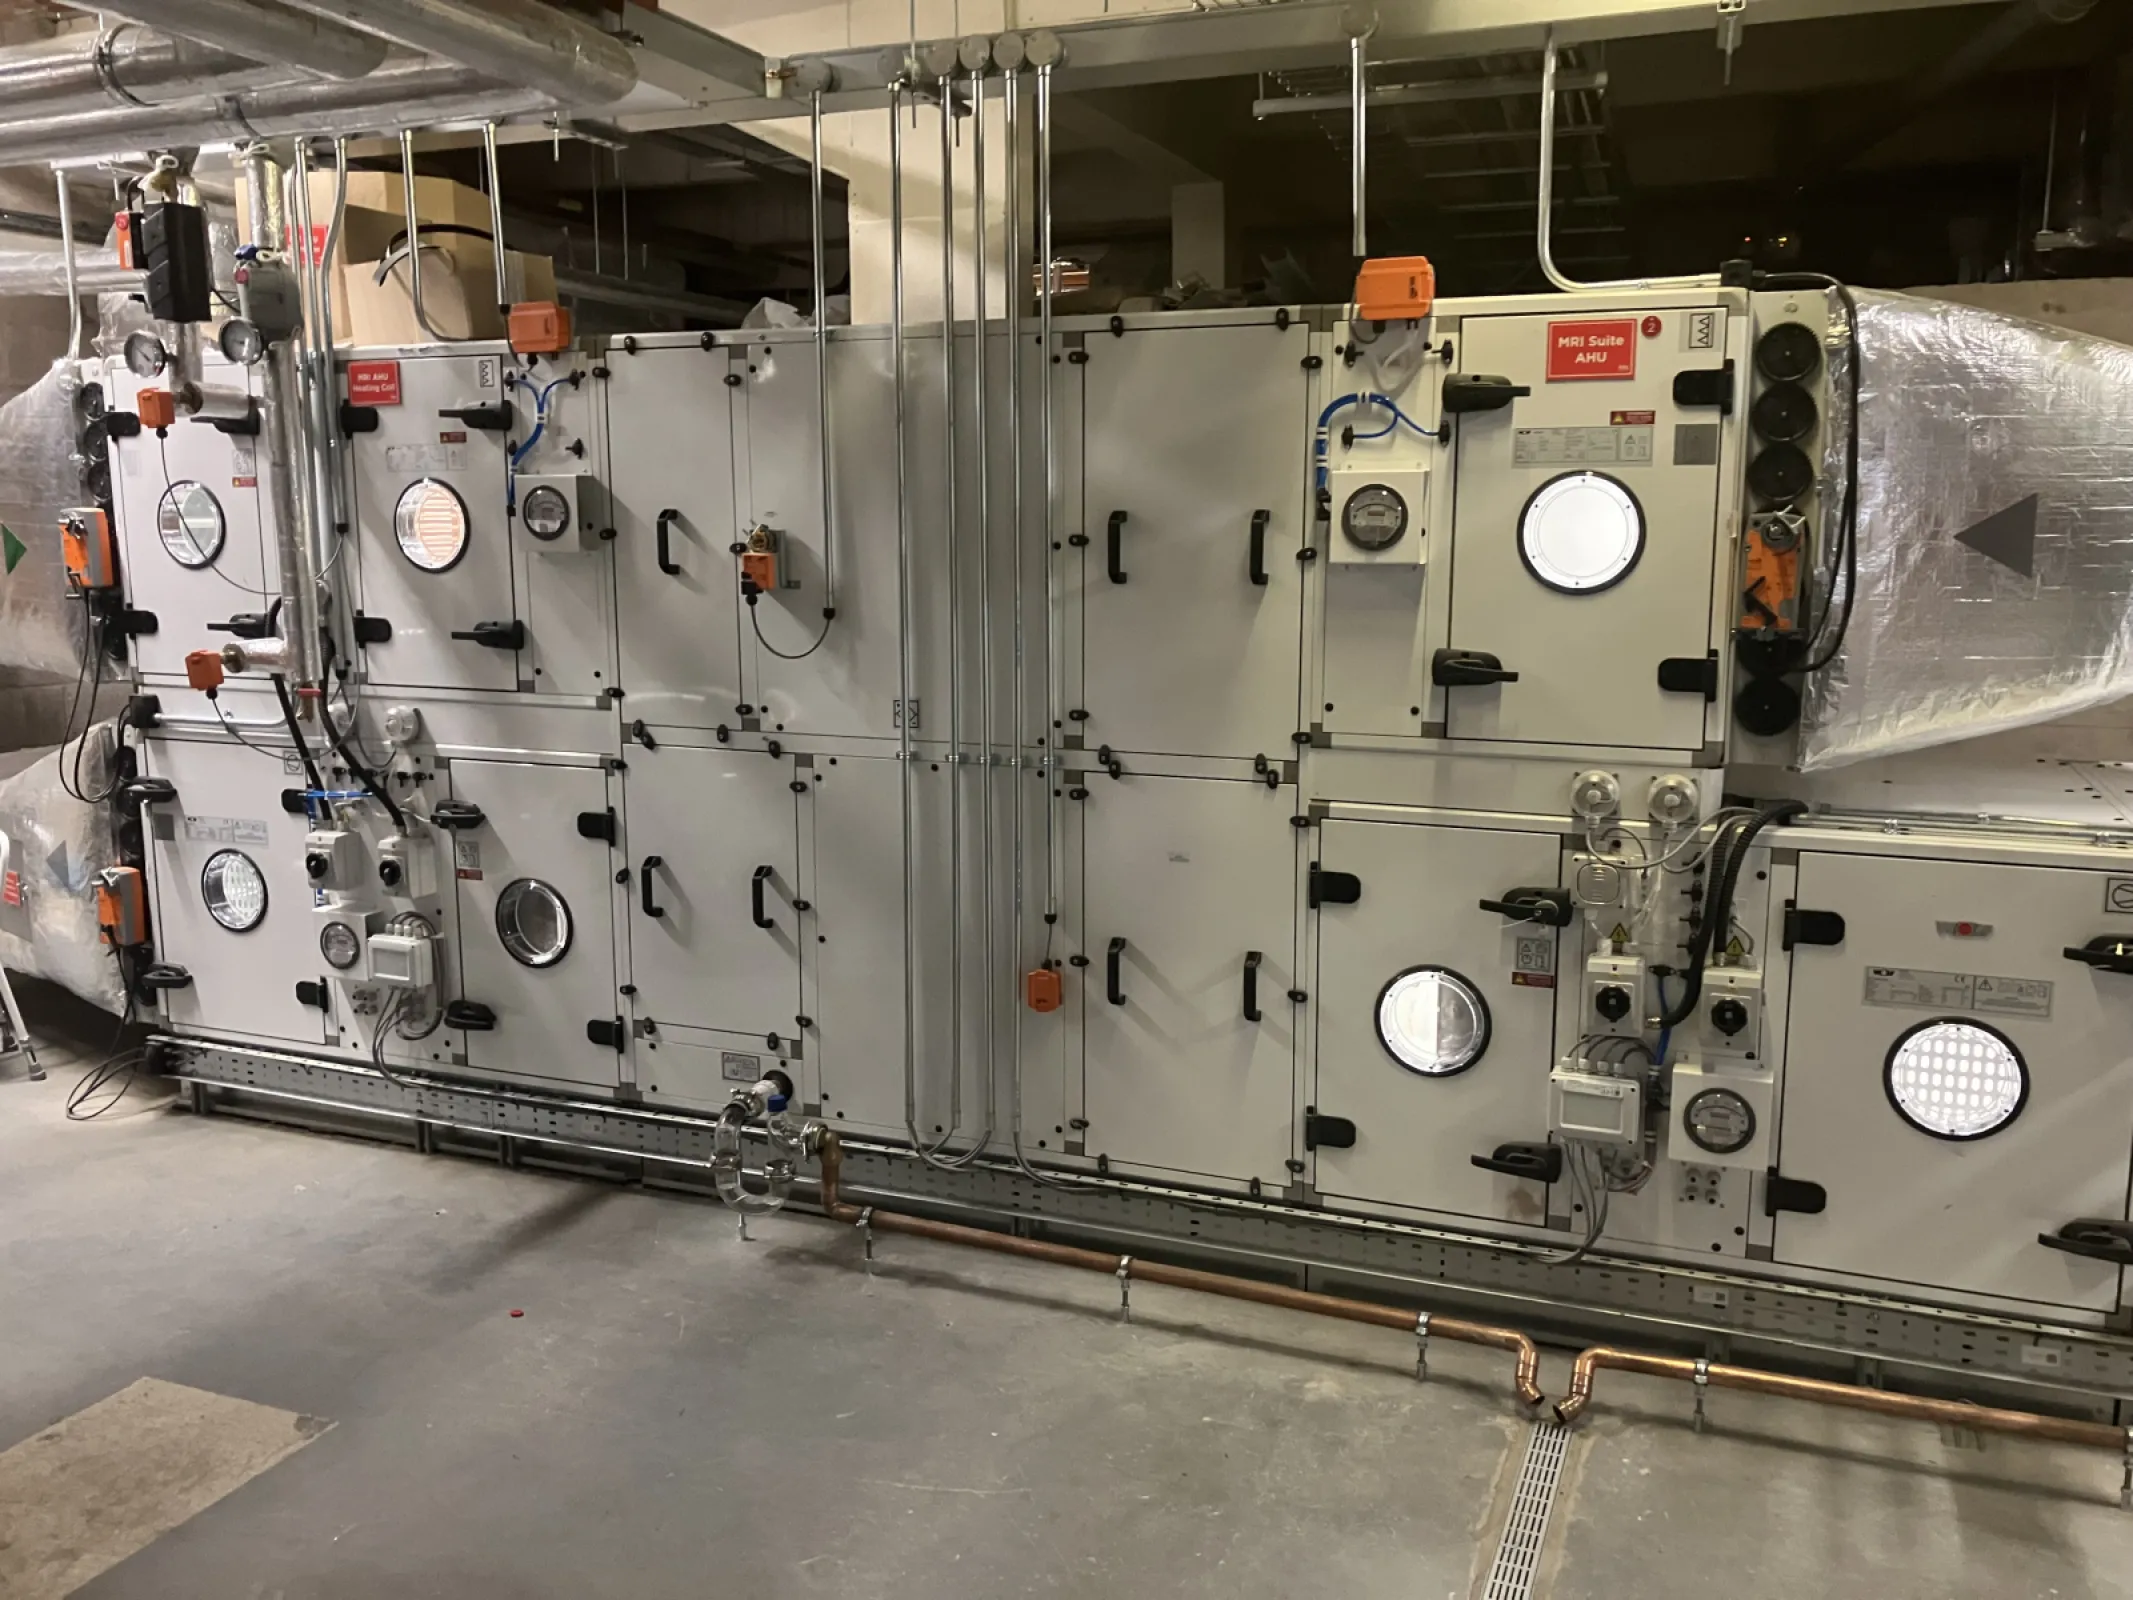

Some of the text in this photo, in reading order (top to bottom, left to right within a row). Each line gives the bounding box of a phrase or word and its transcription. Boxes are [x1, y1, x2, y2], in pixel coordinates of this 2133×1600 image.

[1647, 322, 1656, 333] 2
[1558, 335, 1625, 348] MRI Suite
[1574, 351, 1608, 364] AHU
[372, 372, 388, 381] AHU
[353, 383, 395, 393] Heating Coil
